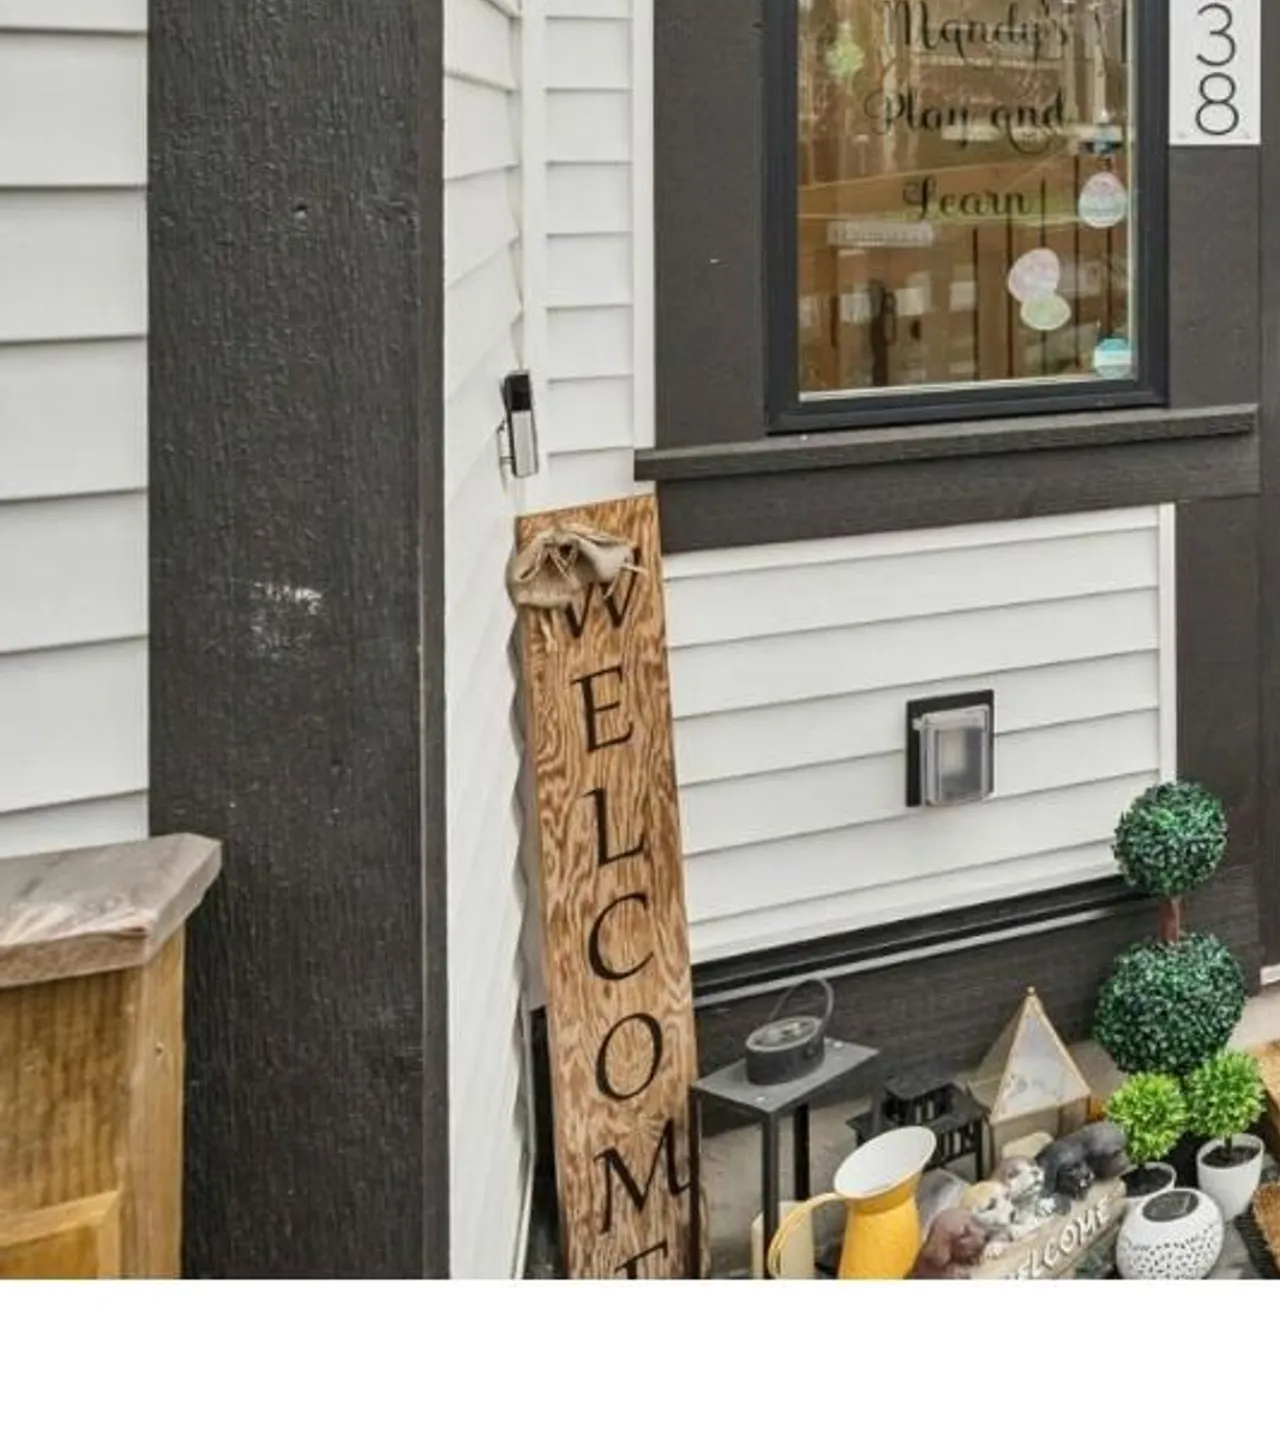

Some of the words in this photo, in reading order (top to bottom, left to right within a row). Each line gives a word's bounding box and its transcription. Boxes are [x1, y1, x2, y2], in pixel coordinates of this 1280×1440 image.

[864, 87, 970, 150] Play
[990, 87, 1068, 154] and
[903, 175, 1030, 221] Learn
